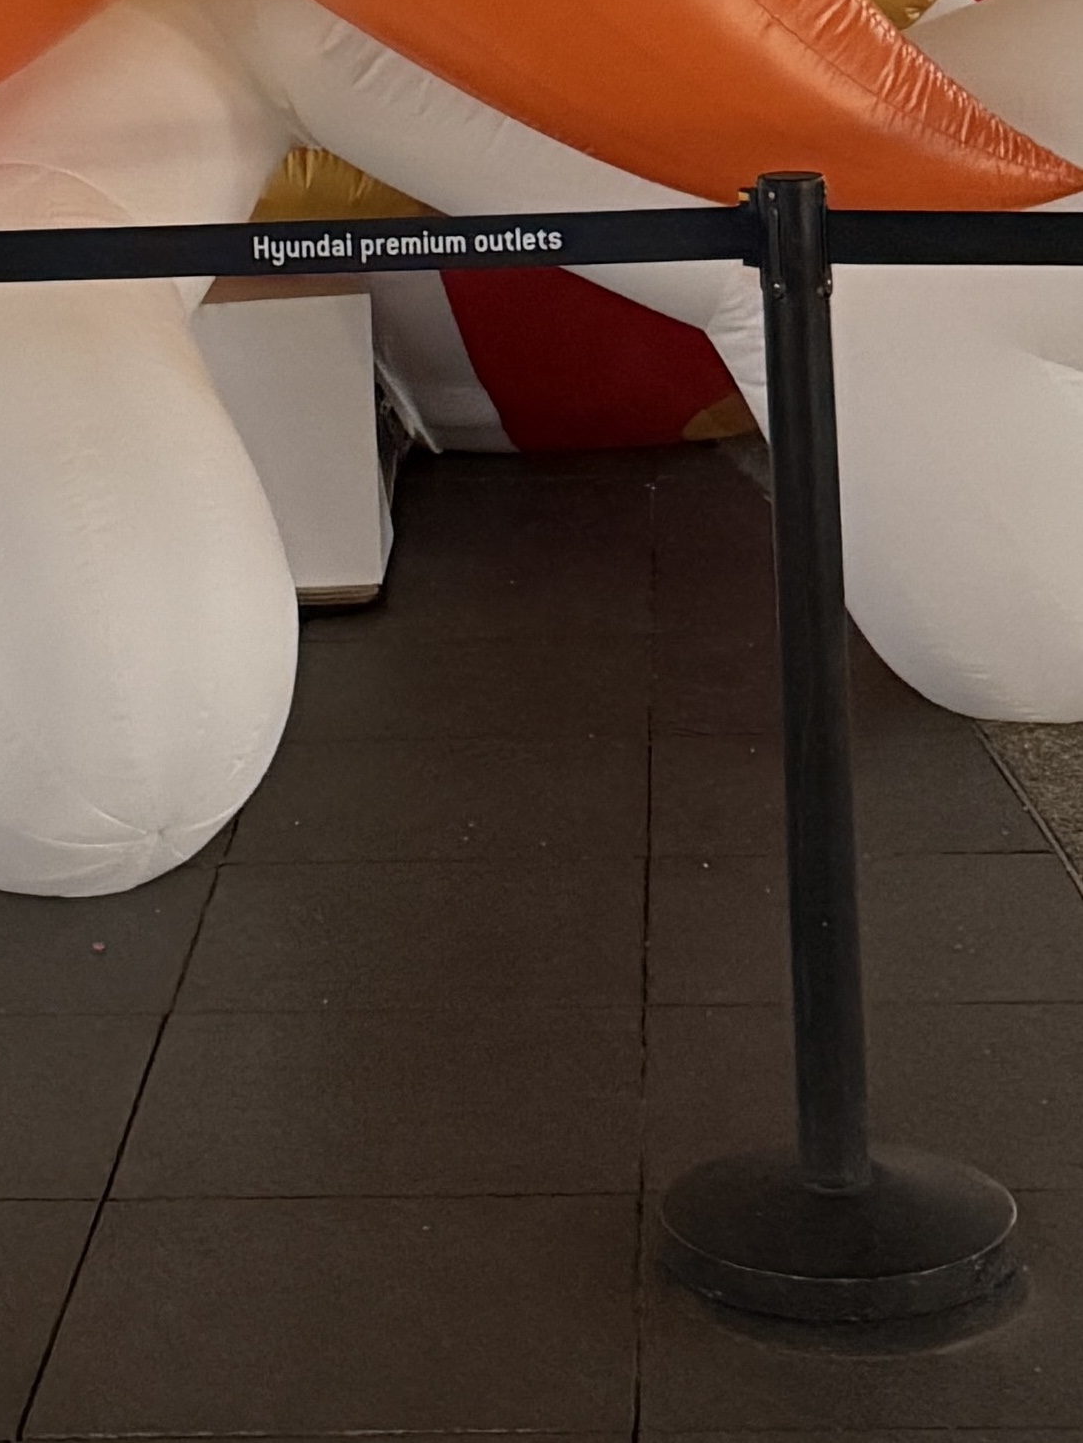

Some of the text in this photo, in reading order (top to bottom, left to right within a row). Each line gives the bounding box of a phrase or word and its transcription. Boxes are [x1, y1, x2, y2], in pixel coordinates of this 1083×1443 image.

[252, 227, 563, 267] Hyundai premium outlets
